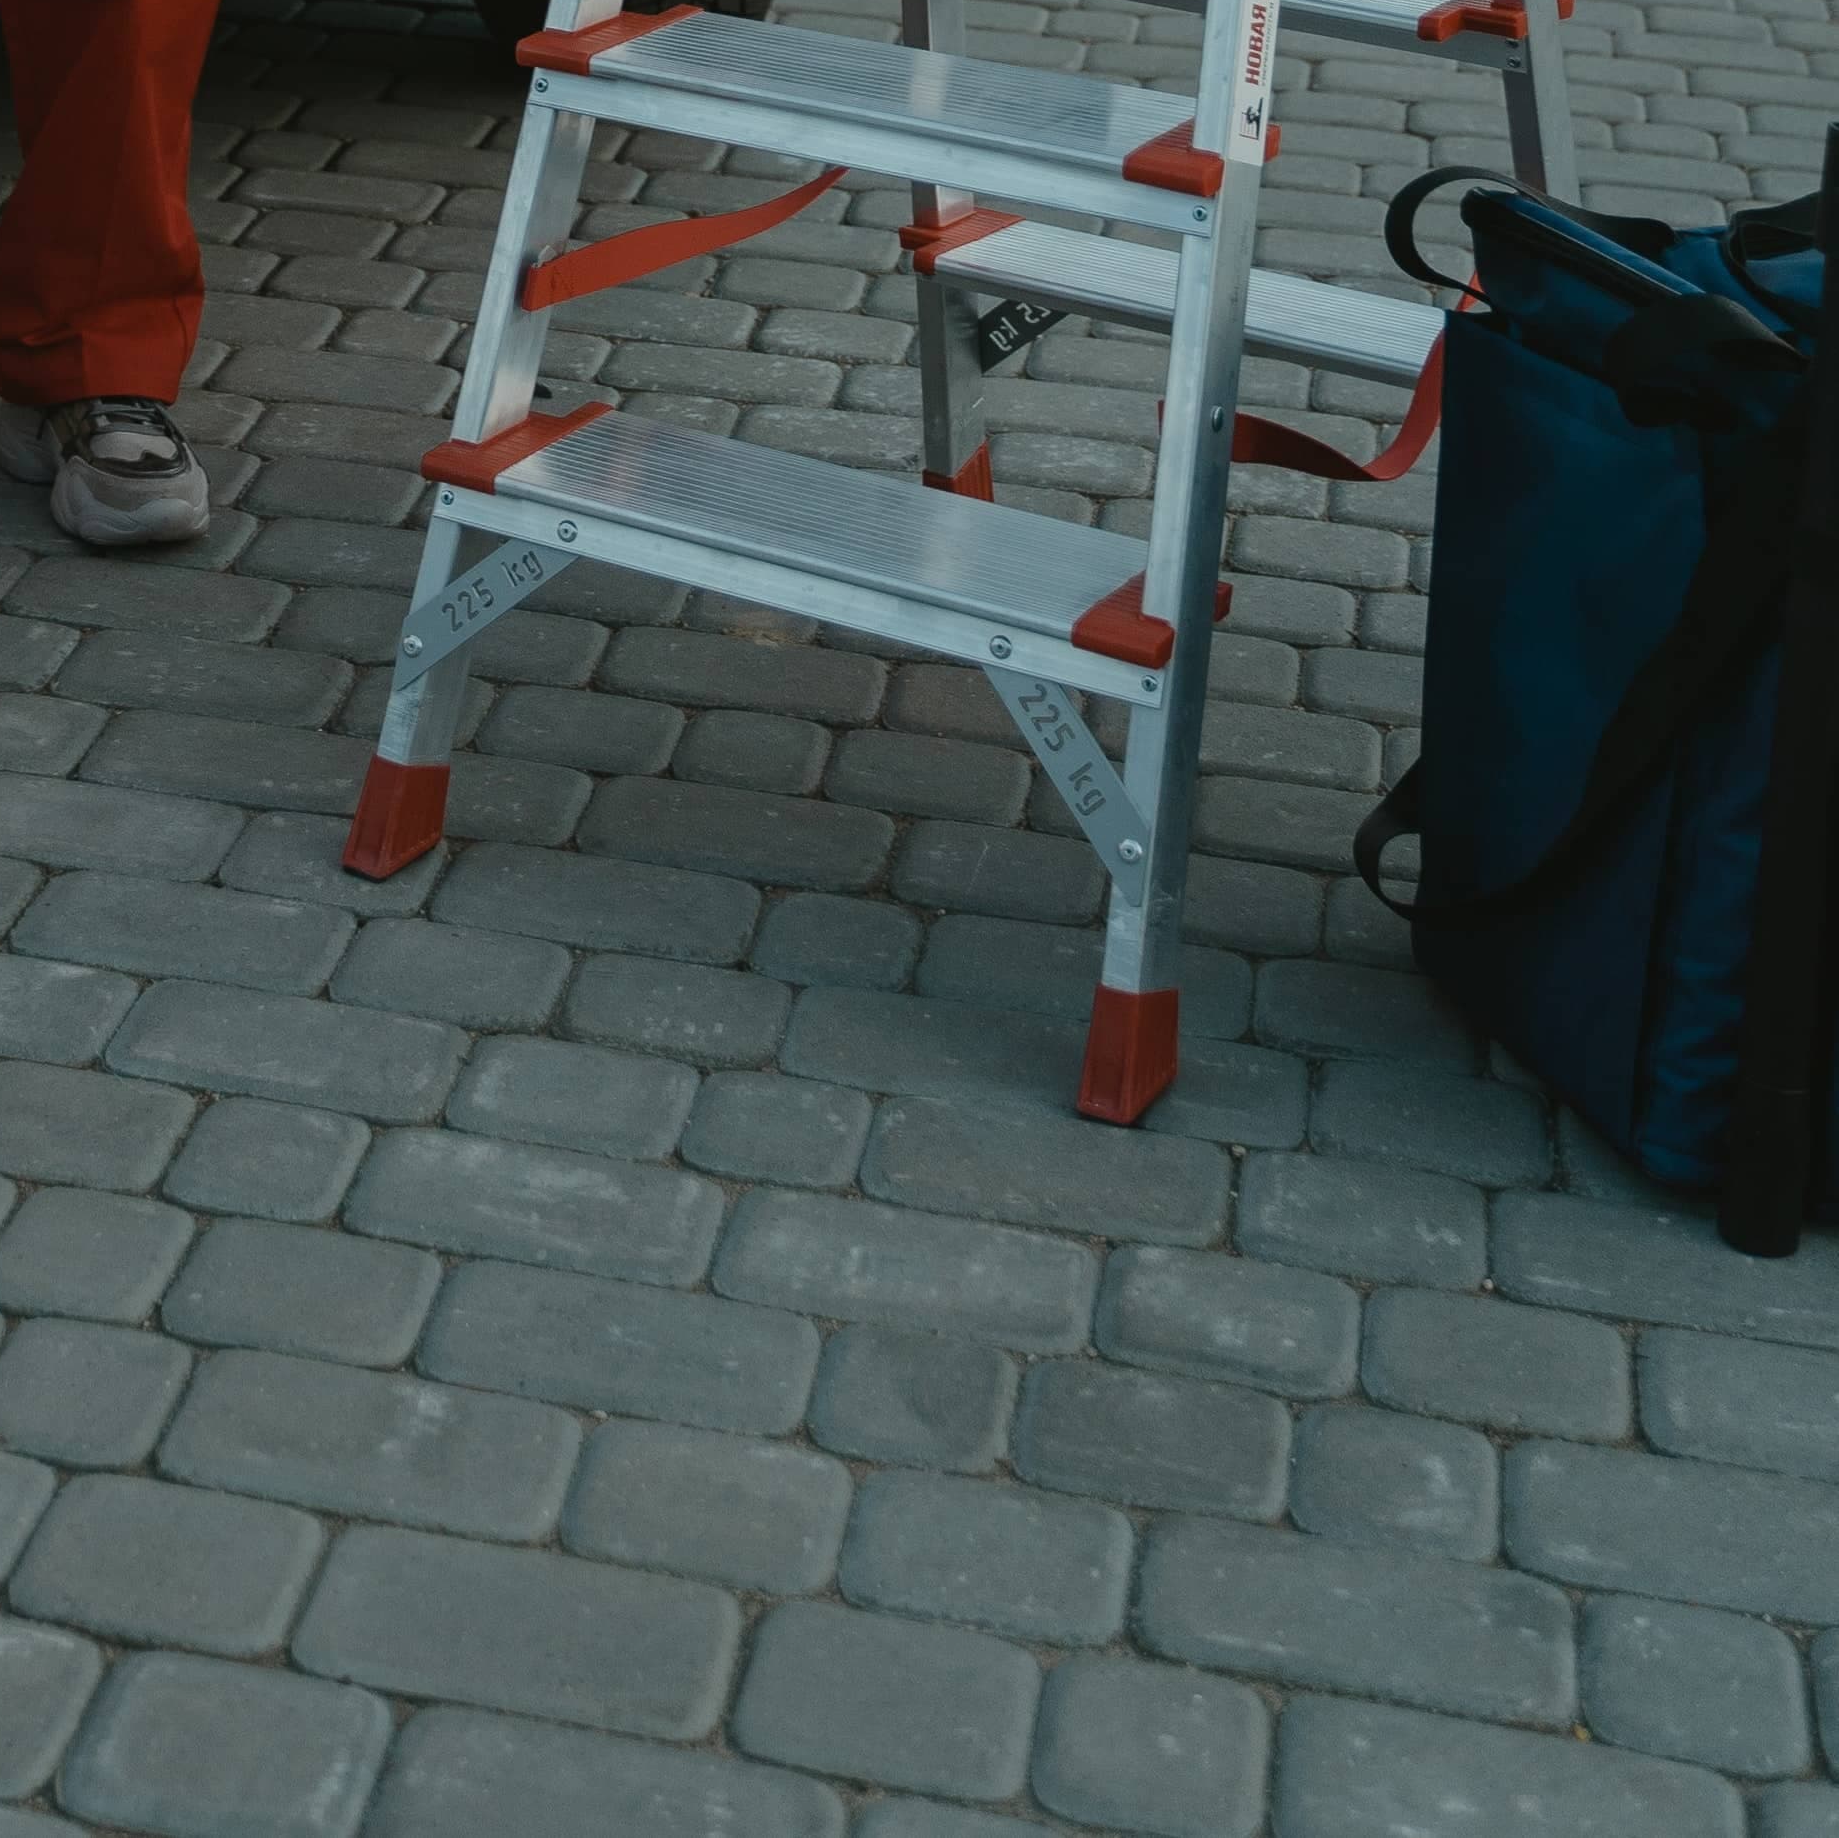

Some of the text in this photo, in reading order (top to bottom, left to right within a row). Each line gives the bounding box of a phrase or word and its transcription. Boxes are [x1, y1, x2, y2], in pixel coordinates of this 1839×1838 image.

[1245, 4, 1267, 86] НОВАЯ
[442, 550, 544, 632] 225 kg
[1018, 683, 1107, 817] 225 kg
